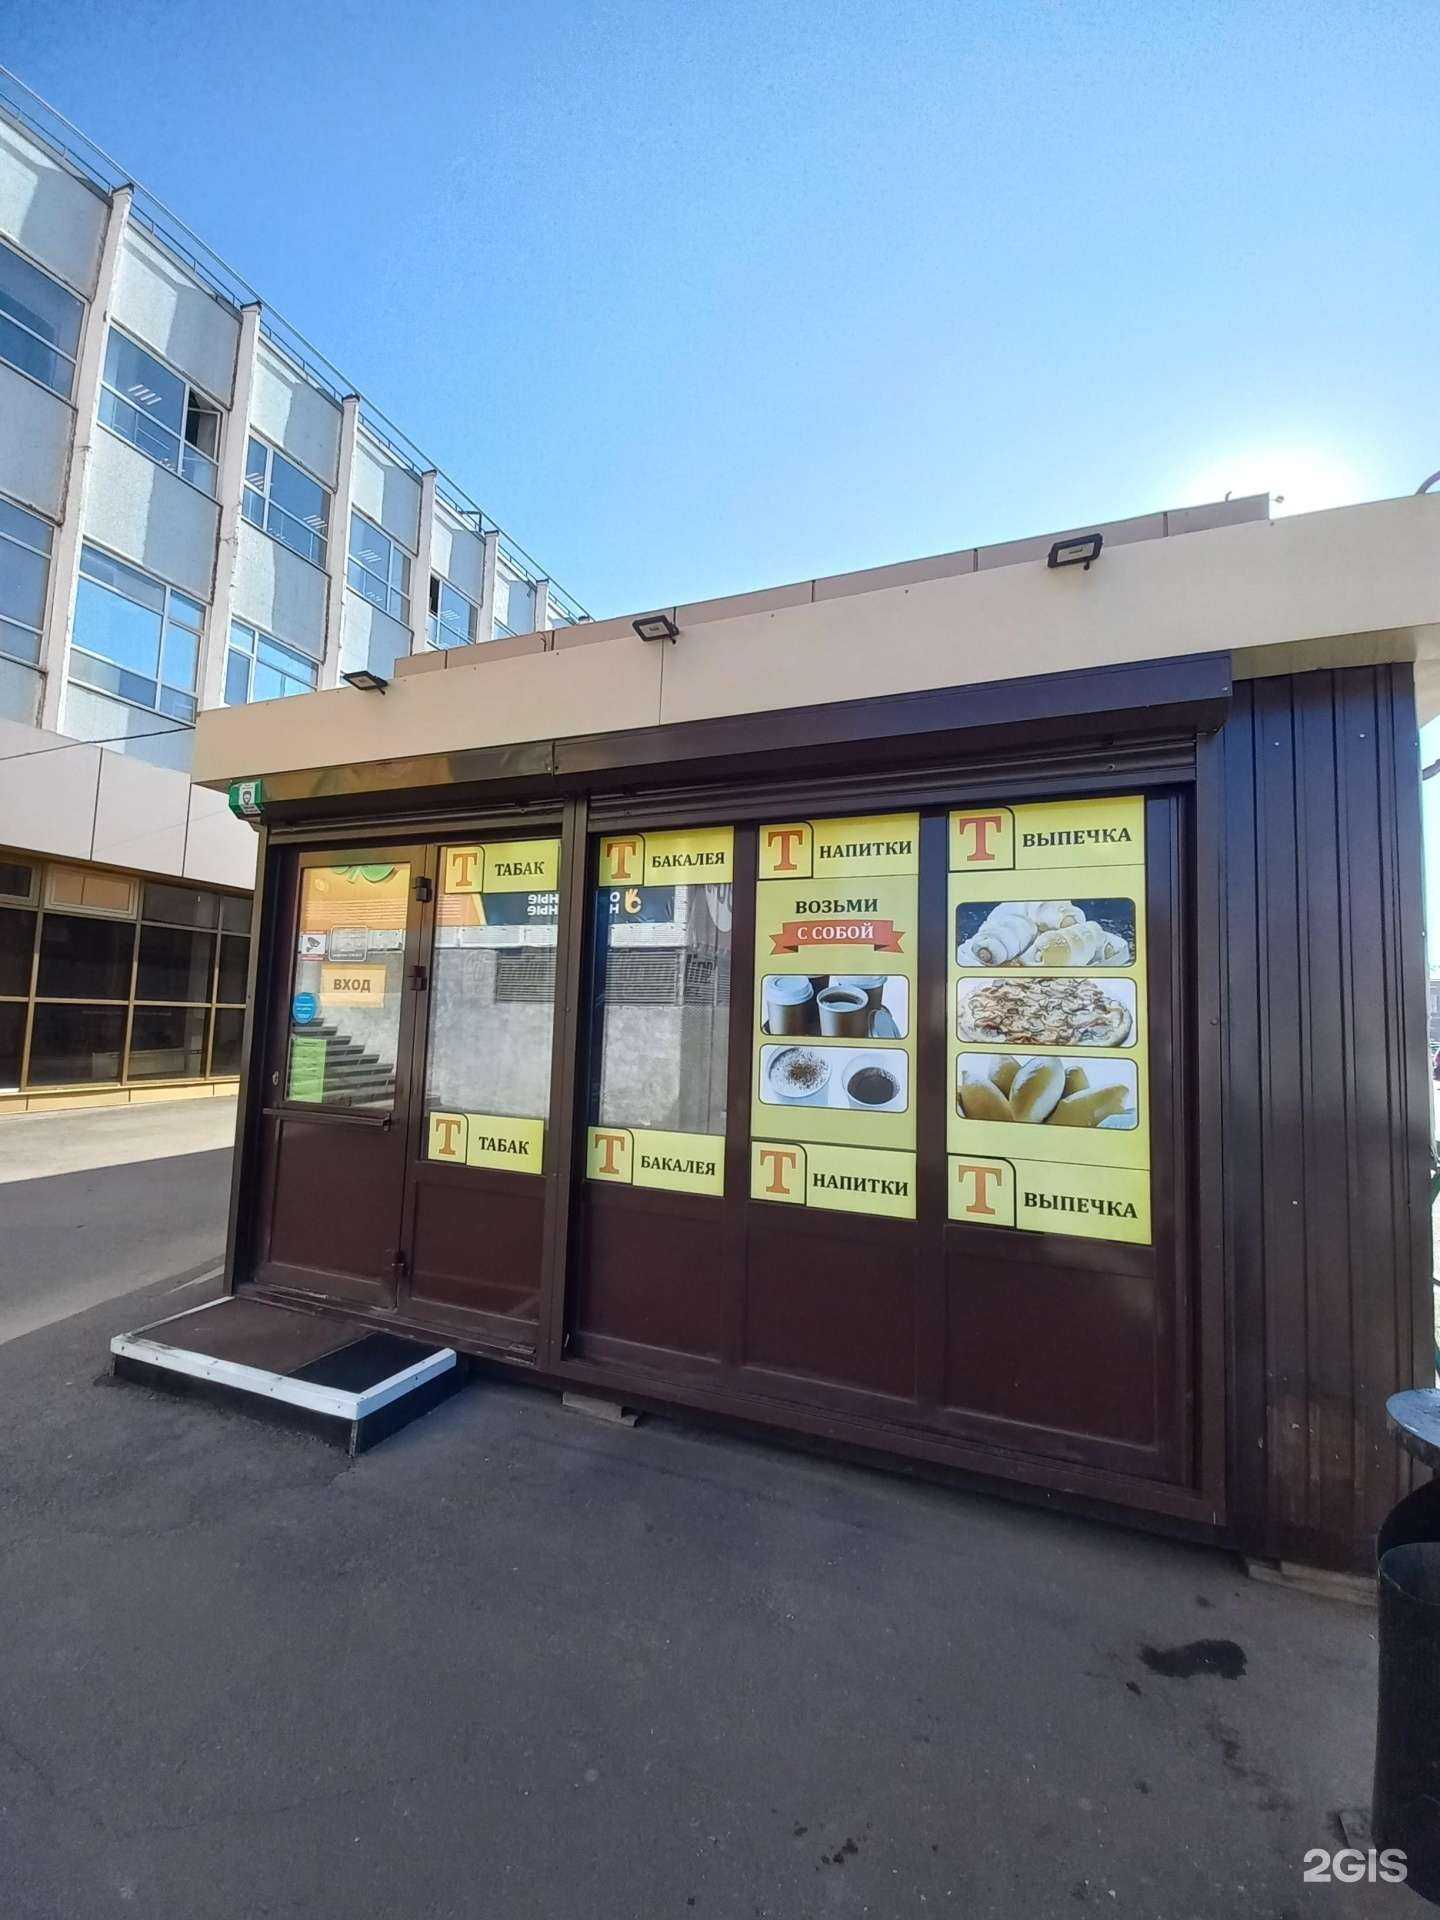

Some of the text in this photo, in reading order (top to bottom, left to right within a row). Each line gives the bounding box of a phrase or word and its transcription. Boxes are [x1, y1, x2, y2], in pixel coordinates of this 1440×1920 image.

[1022, 827, 1132, 848] ВЫПЕЧКА
[819, 840, 912, 859] НАПИТКИ
[494, 861, 545, 877] ТАБАК
[651, 851, 725, 868] БАКАЛЕЯ
[795, 898, 879, 915] ВОЗЬМИ
[797, 919, 874, 941] С СОБОЙ
[333, 978, 371, 993] ВХОД
[478, 1136, 530, 1155] ТАБАК
[640, 1155, 717, 1176] БАКАЛЕЯ
[812, 1173, 909, 1197] НАПИТКИ
[1023, 1191, 1139, 1219] ВЫПЕЧКА
